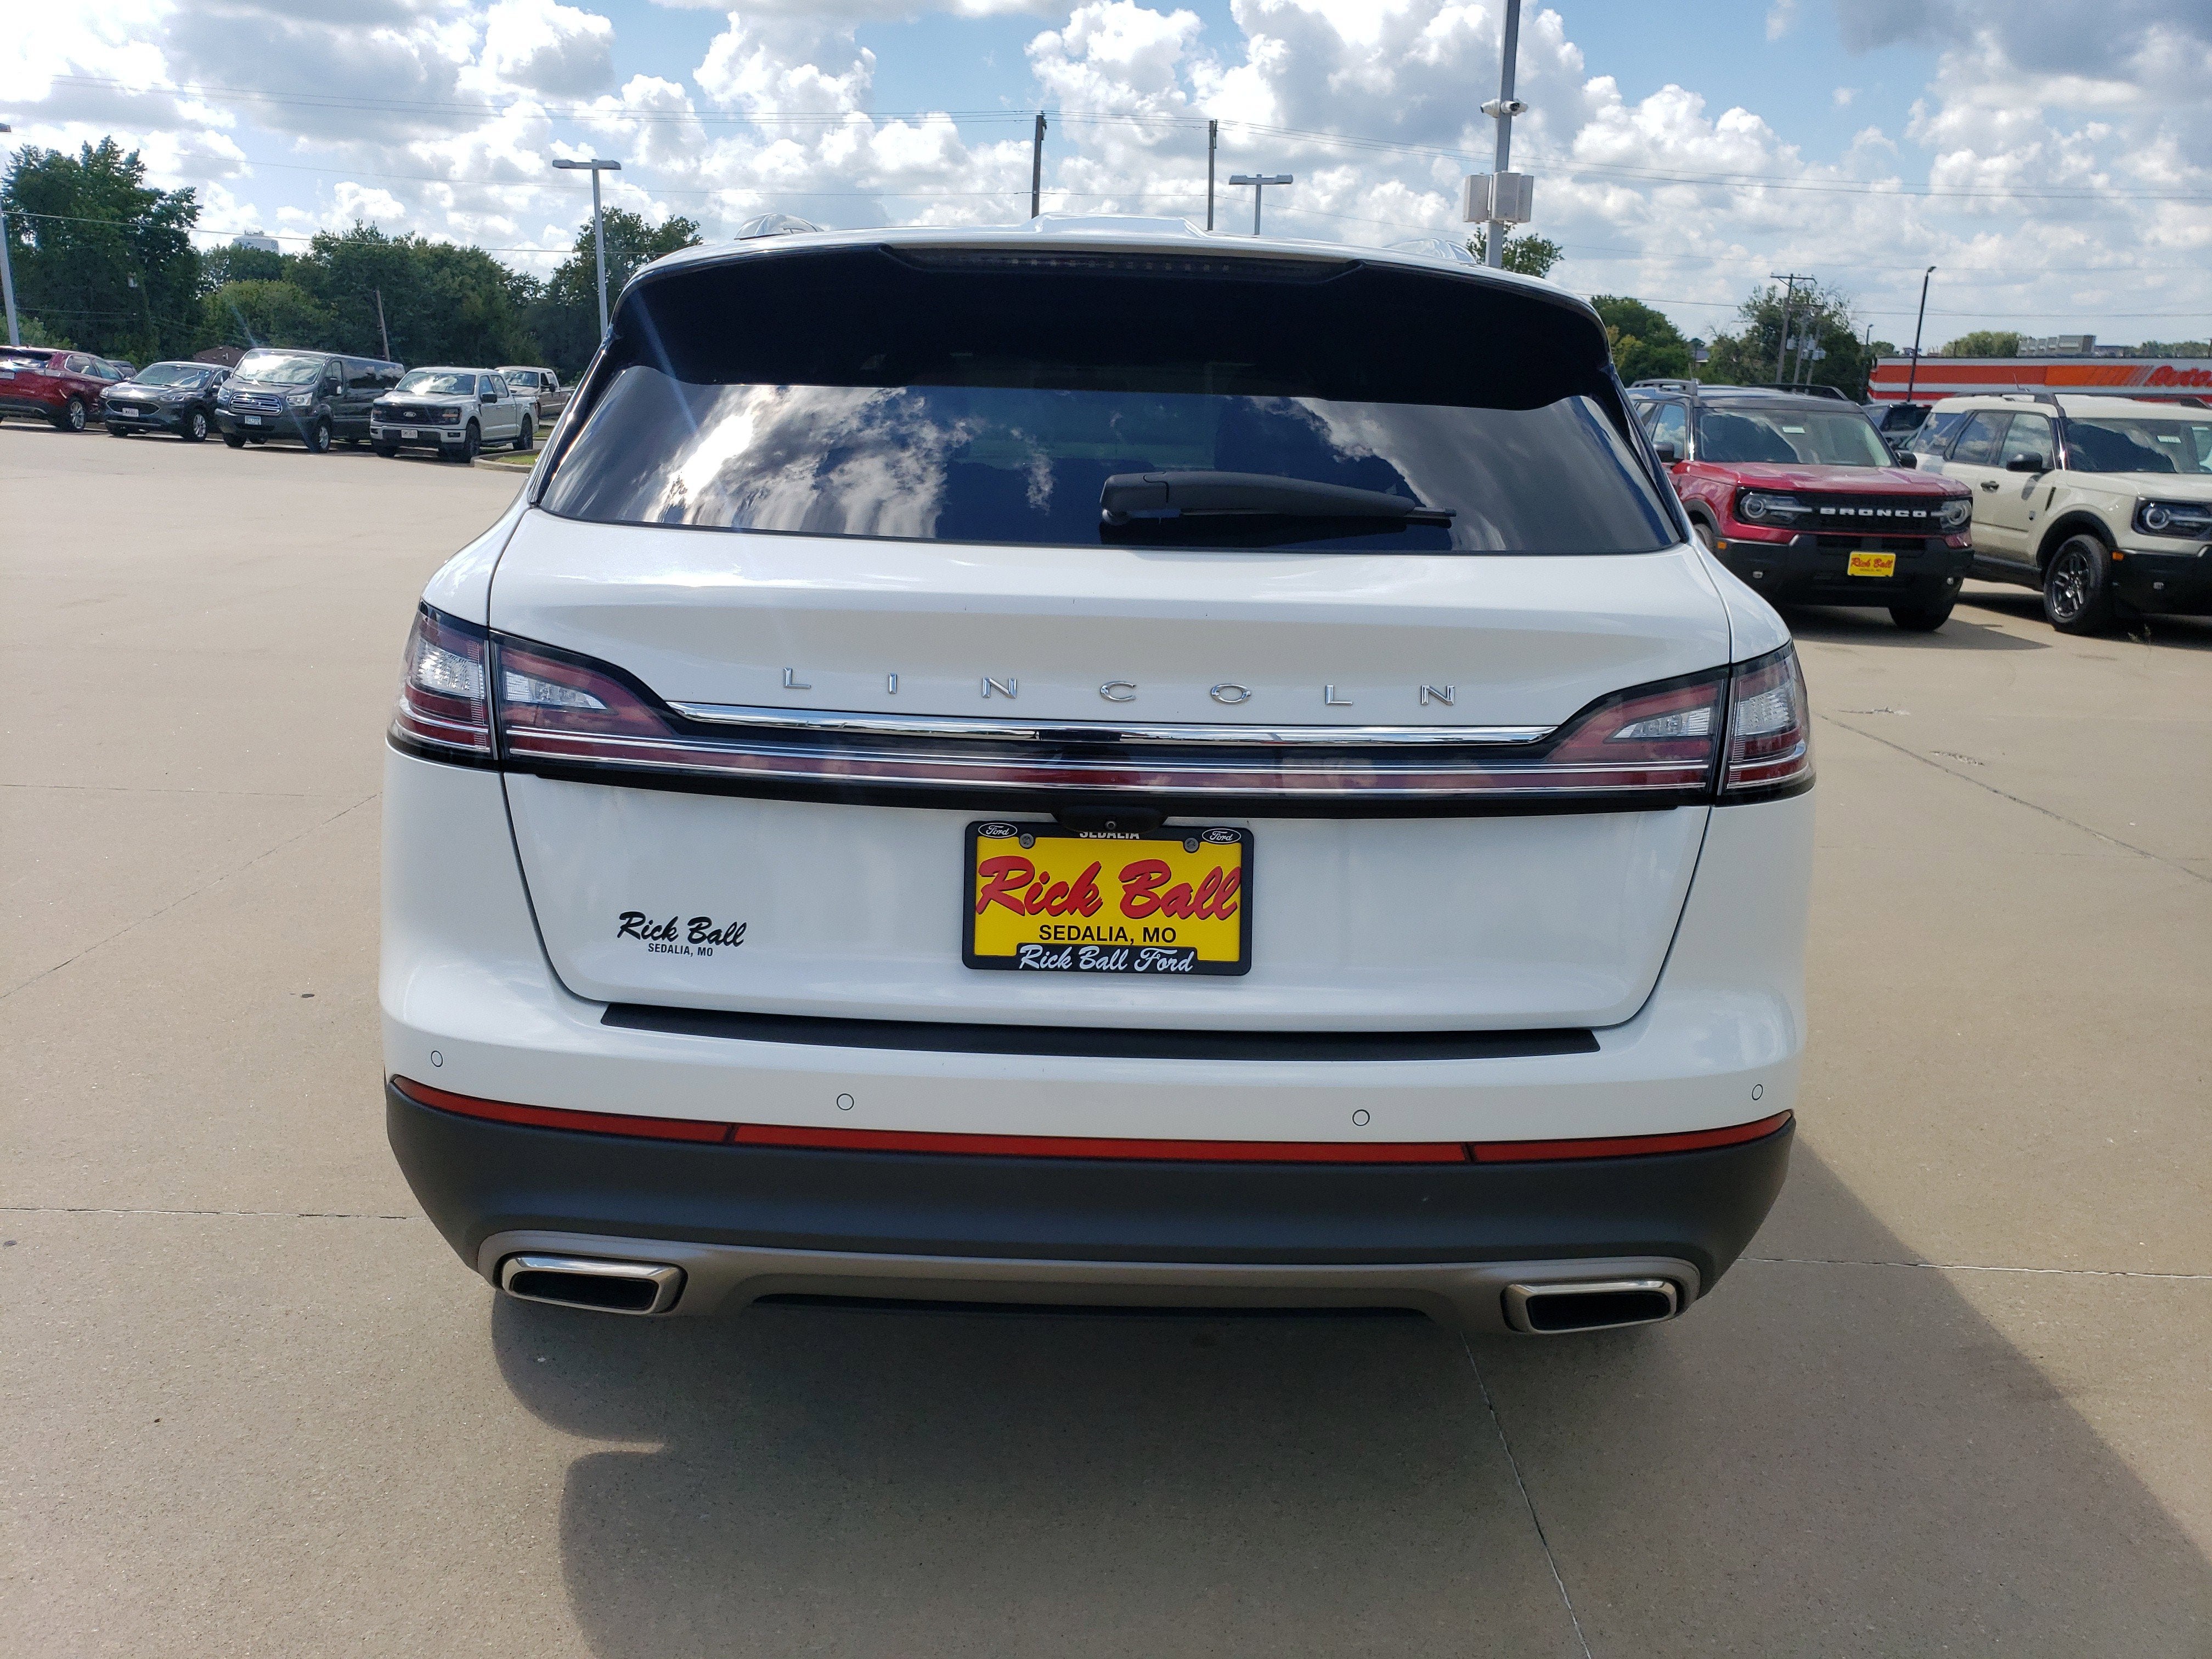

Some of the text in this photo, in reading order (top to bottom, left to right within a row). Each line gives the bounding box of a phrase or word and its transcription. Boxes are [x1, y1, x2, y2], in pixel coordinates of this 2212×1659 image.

[1820, 506, 1927, 518] BRONCO
[782, 667, 1455, 707] LINCOLN
[986, 825, 1009, 835] Ford
[1210, 831, 1233, 841] Ford
[976, 856, 1241, 921] Rick Ball
[617, 911, 747, 947] Rick Ball
[1039, 925, 1177, 944] SEDALIA, MO
[648, 943, 713, 957] SEDALIA, MO
[1019, 944, 1194, 972] Rick Ball Ford
